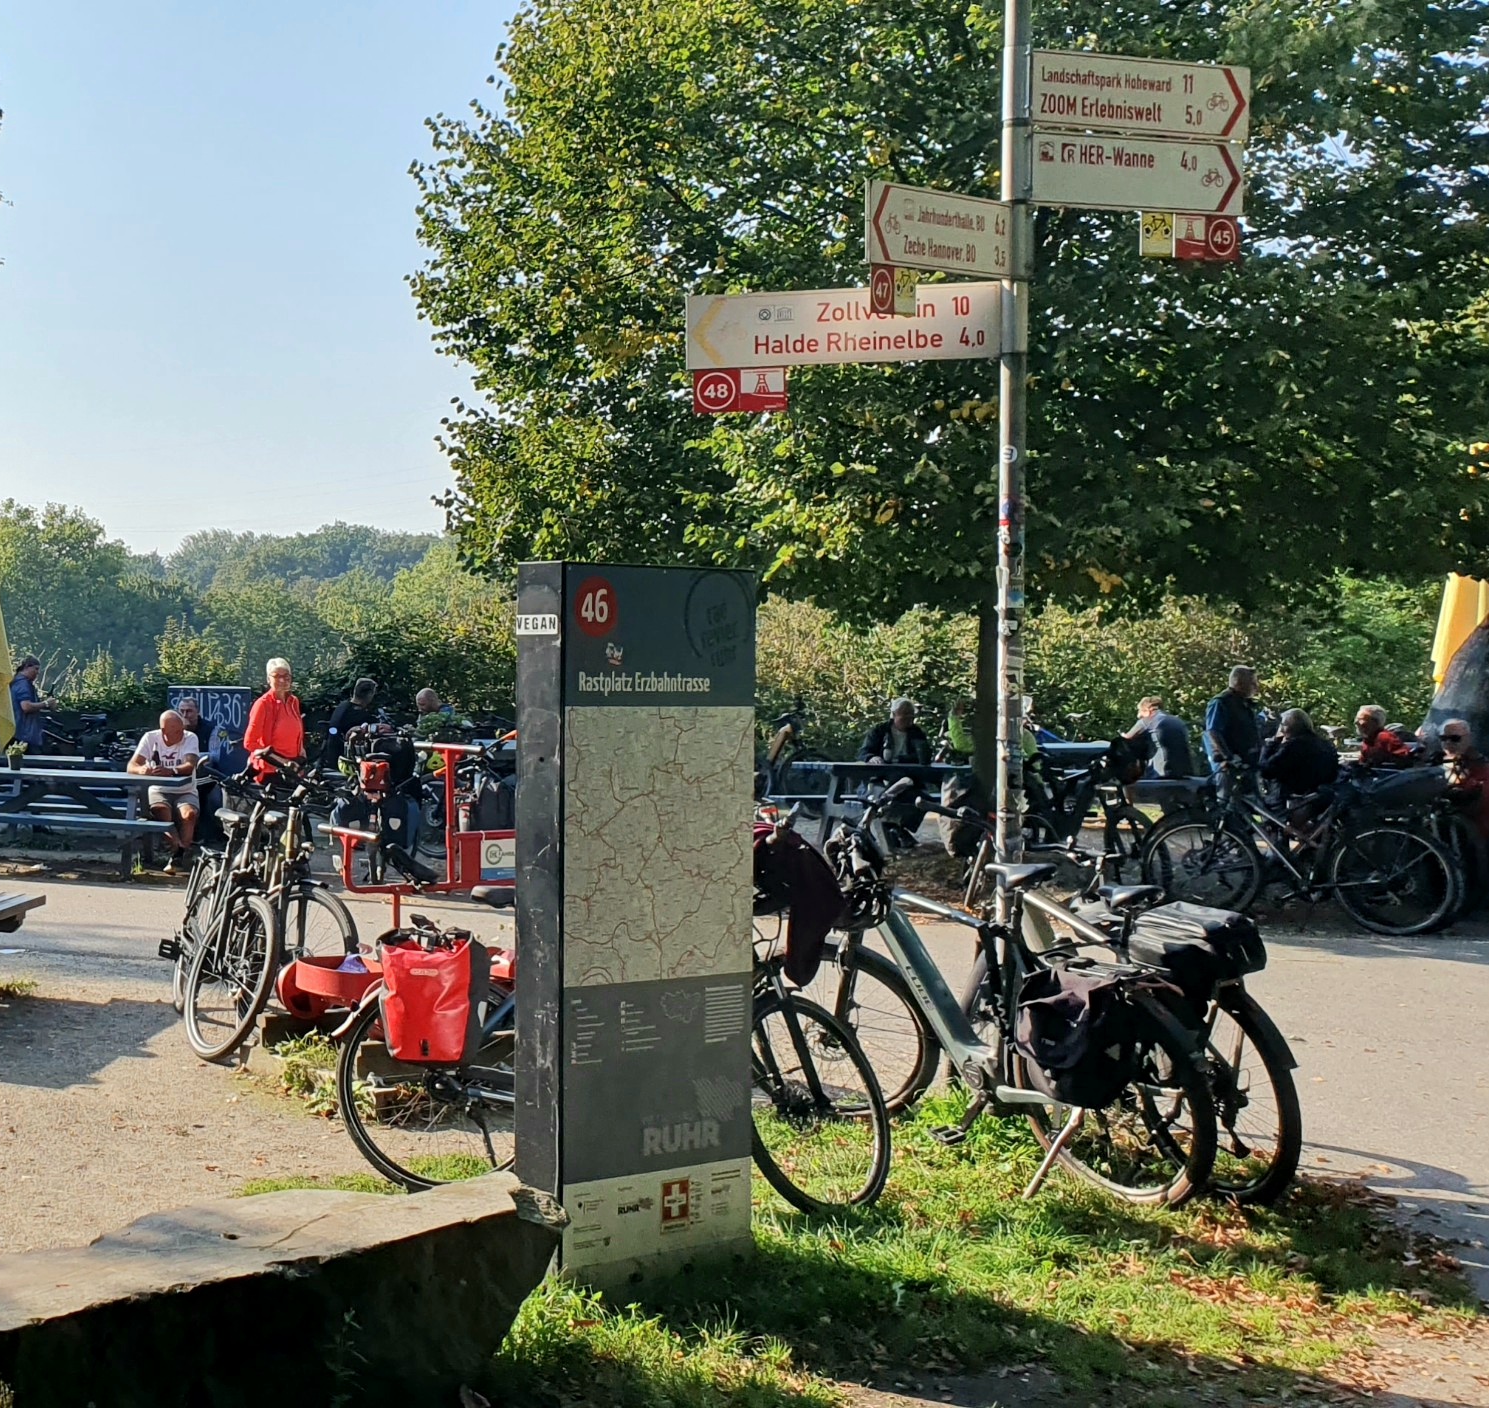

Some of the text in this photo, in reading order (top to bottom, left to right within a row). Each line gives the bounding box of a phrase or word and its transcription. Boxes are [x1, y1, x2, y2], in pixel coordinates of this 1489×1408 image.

[1041, 66, 1122, 91] Landschaftspark
[1183, 74, 1194, 94] 11
[1040, 93, 1203, 126] ZOOM Erlebniswelt 5,0
[1079, 145, 1198, 171] HER-Wanne 4,0
[903, 235, 926, 256] Zeche
[966, 244, 976, 263] BO
[1213, 230, 1231, 245] 45
[875, 283, 888, 299] 47
[816, 296, 970, 323] Zollvin 10
[754, 327, 985, 355] Halde Rheinelbe 4,0
[703, 383, 728, 399] 48
[580, 588, 609, 623] 46
[516, 616, 557, 630] VEGAN
[578, 671, 711, 697] Rastplatz Erzbahntrasse
[643, 1119, 721, 1157] RUHR
